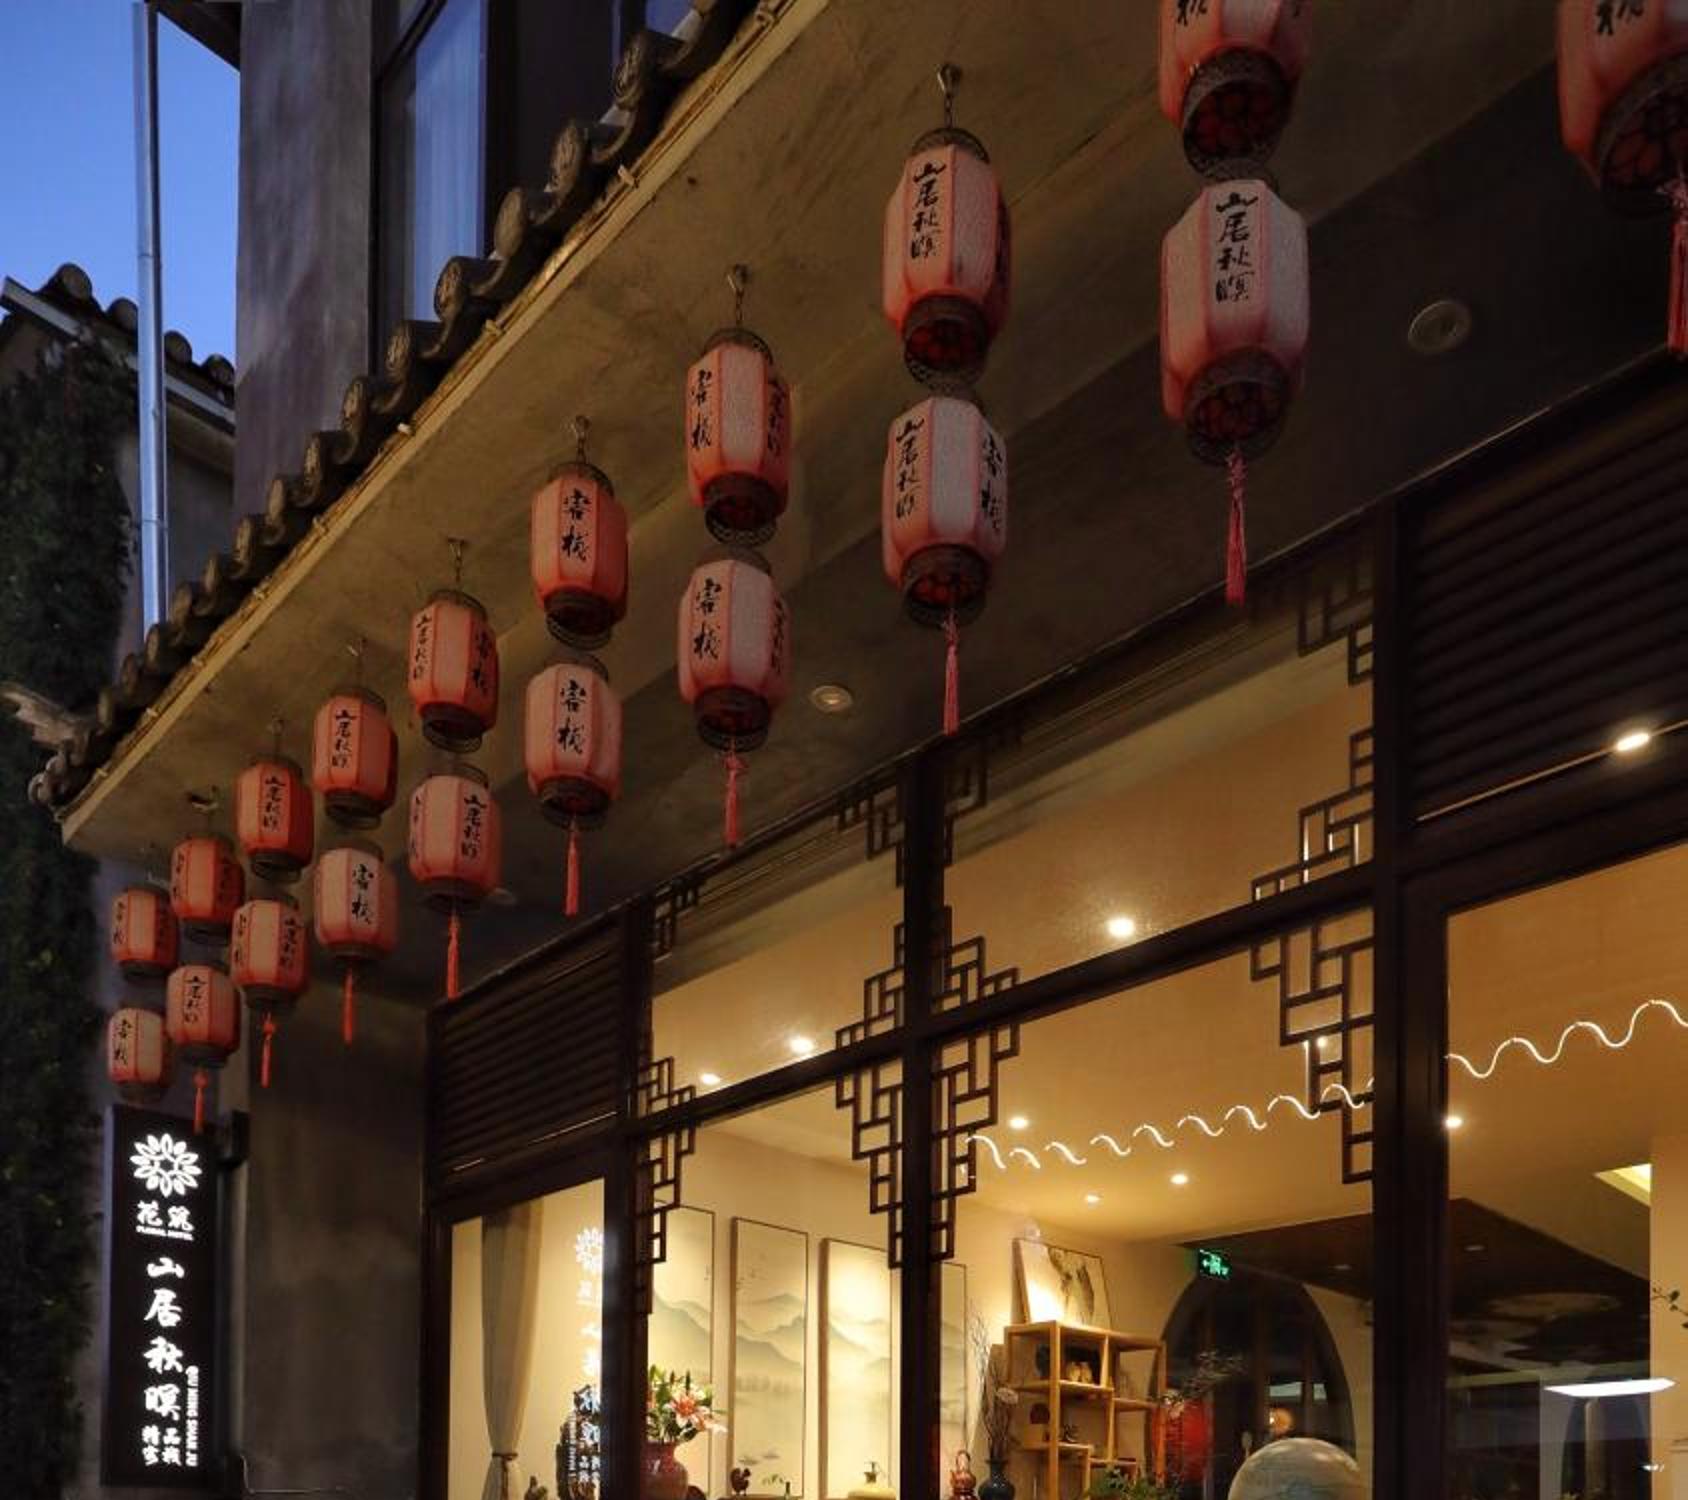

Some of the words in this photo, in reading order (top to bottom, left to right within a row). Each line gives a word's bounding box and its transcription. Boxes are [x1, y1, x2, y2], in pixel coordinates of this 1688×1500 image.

[1215, 192, 1259, 303] 山居秋暝
[561, 487, 591, 563] 客栈
[557, 679, 588, 754] 客栈
[136, 1200, 195, 1231] 花筑
[144, 1257, 185, 1421] 山居秋暝
[185, 1451, 198, 1467] JU
